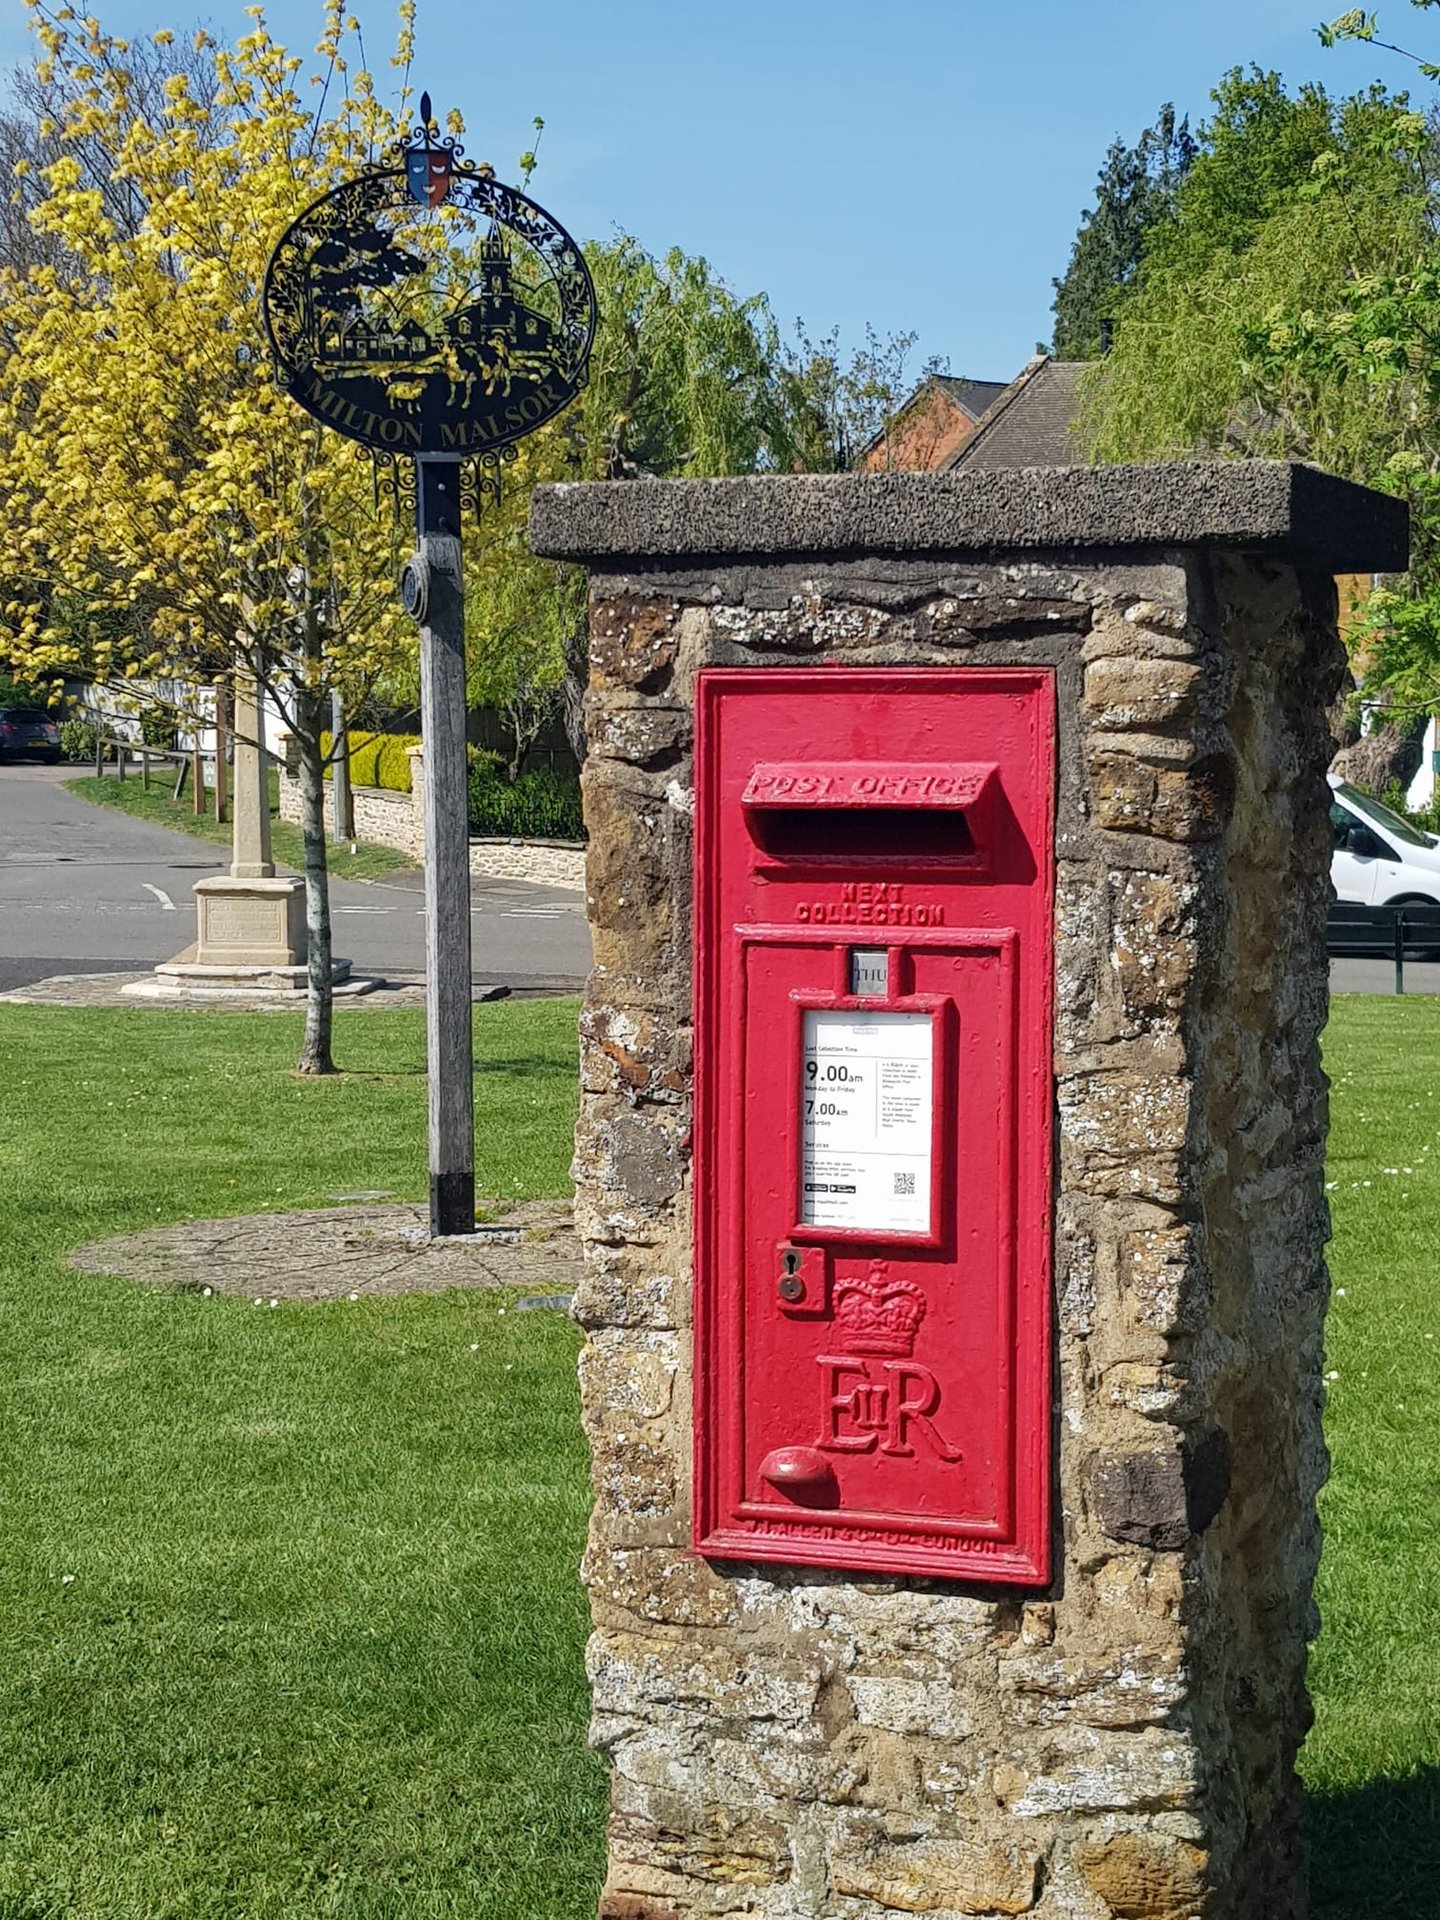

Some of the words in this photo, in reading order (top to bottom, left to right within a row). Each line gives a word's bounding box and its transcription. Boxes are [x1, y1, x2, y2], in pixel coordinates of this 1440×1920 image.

[303, 377, 423, 446] MILTON
[440, 384, 563, 446] MALSOR
[751, 775, 835, 796] POST
[852, 775, 984, 797] OFFICE
[842, 883, 904, 904] NEXT
[795, 902, 944, 925] COLLECTION
